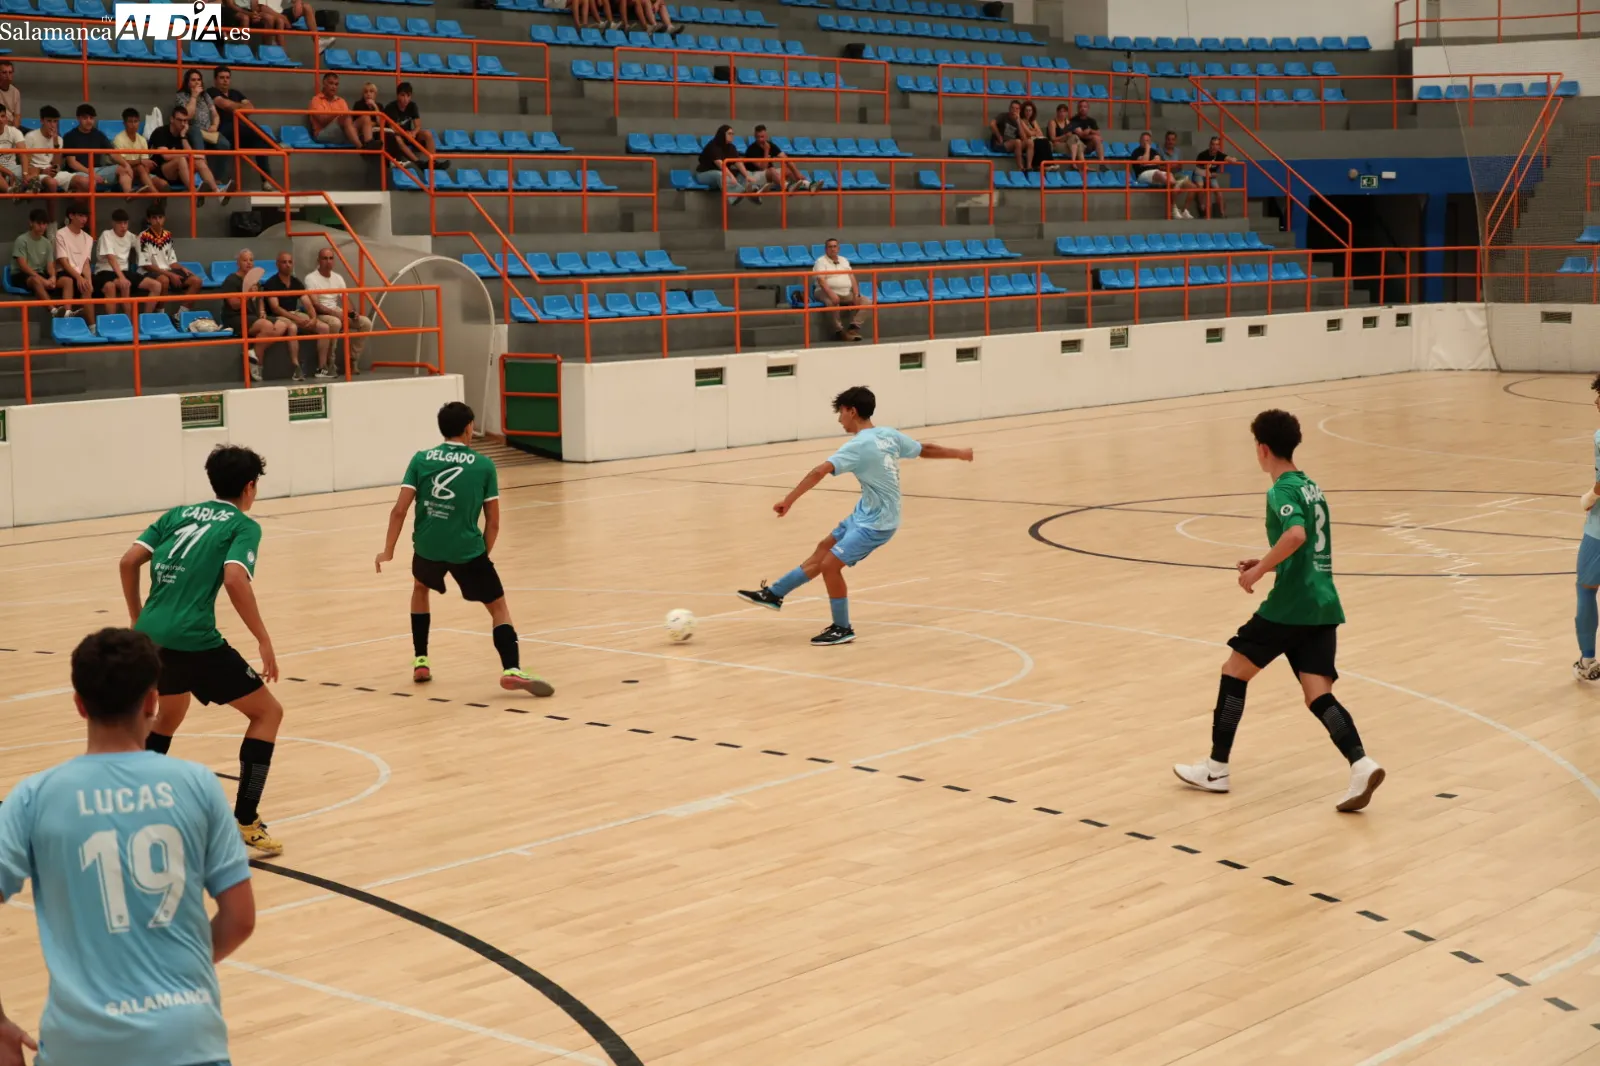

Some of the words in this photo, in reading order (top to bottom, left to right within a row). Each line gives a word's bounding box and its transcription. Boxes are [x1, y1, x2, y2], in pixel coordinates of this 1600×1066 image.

[425, 449, 475, 464] DELGADO
[431, 466, 464, 500] 8
[182, 506, 234, 521] CARLOS
[1314, 503, 1326, 552] 3
[168, 522, 211, 559] 11
[77, 781, 175, 816] LUCAS
[79, 823, 186, 934] 19
